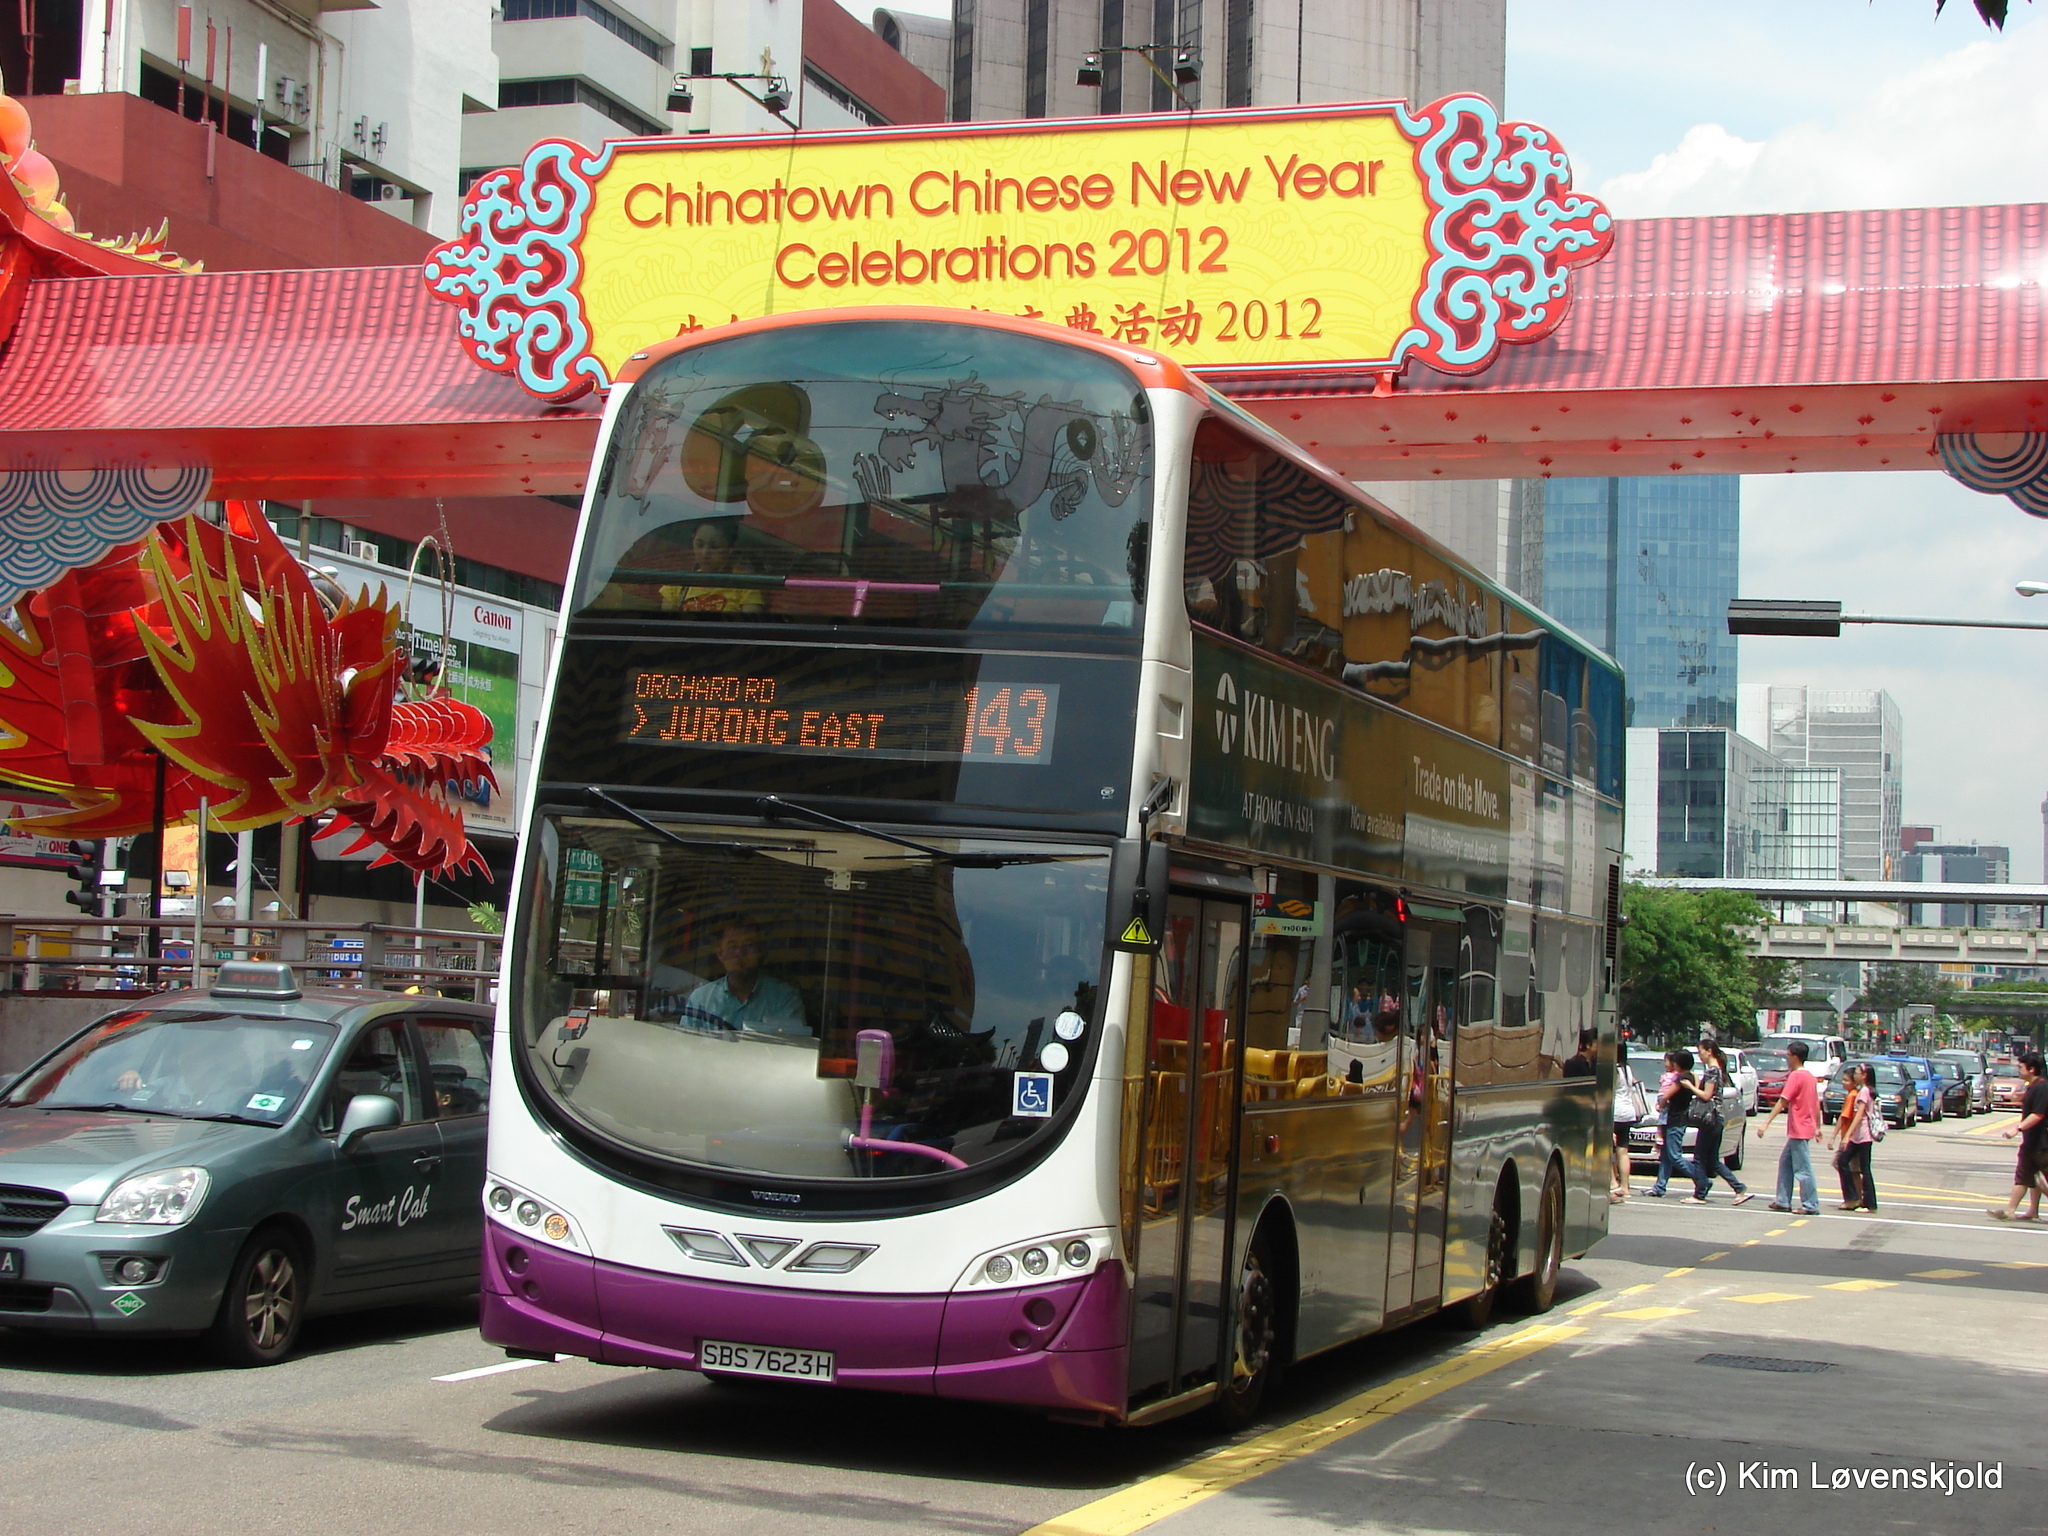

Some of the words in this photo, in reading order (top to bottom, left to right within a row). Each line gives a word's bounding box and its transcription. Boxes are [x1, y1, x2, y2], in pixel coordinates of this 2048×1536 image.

[624, 178, 894, 229] Chinatown
[909, 168, 1115, 217] Chinese
[1131, 160, 1252, 208] New
[1263, 153, 1385, 202] Year
[775, 238, 1097, 290] Celebrations
[1108, 226, 1230, 277] 2012
[1215, 297, 1323, 342] 2012
[474, 605, 512, 630] Canon
[415, 632, 458, 657] Timelss
[636, 673, 739, 702] ORCHARD
[744, 677, 777, 703] RD
[660, 705, 789, 745] JURONG
[800, 711, 885, 749] EAST
[963, 686, 1048, 757] 143
[1243, 690, 1287, 768] KIM
[1292, 707, 1335, 782] ENG
[1413, 755, 1441, 803] Trade
[1443, 776, 1456, 807] on
[1457, 773, 1473, 812] the
[1474, 778, 1500, 820] Move.
[1242, 792, 1254, 819] AT
[1254, 794, 1283, 827] HOME
[1283, 802, 1296, 830] IN
[1295, 805, 1314, 834] ASIA
[1350, 805, 1367, 831] Now
[36, 840, 48, 852] Air
[49, 840, 69, 854] ONE
[341, 1194, 396, 1231] Smart
[397, 1184, 430, 1227] Cab
[751, 1190, 801, 1204] VOLVO
[118, 1299, 139, 1308] CNG
[703, 1344, 833, 1378] SBS7623H
